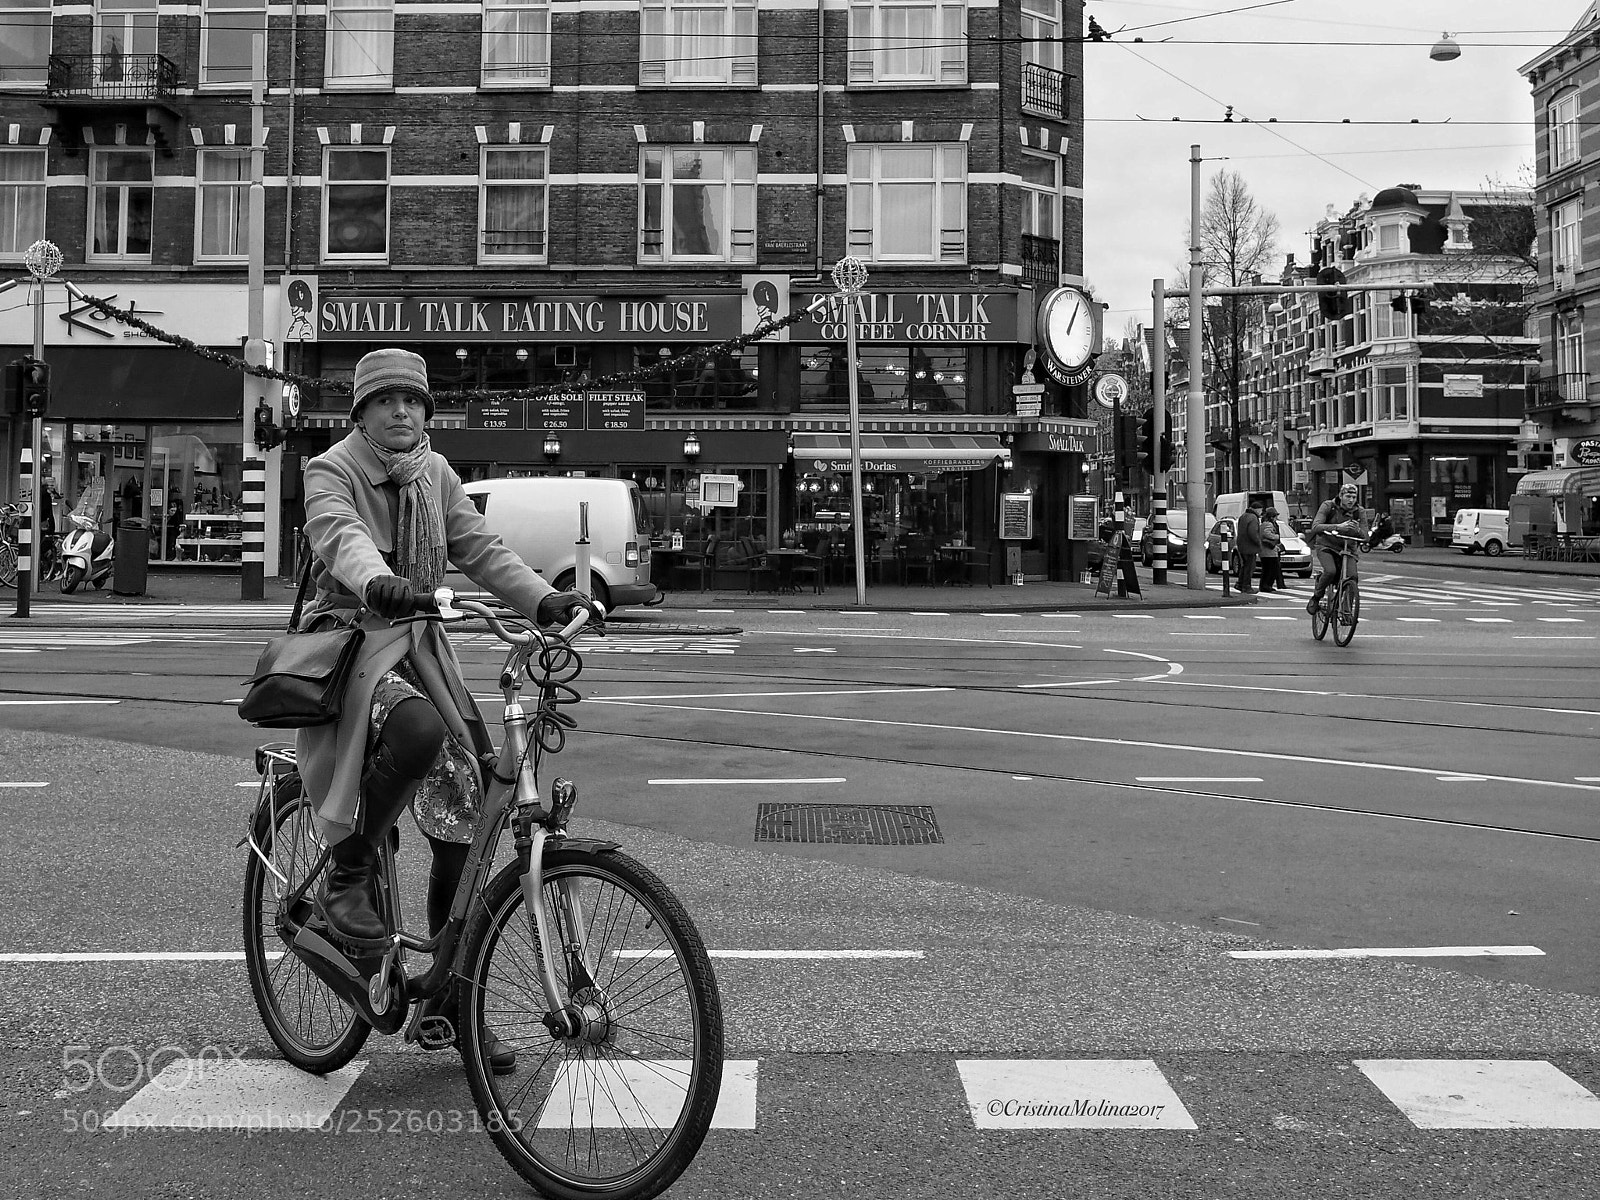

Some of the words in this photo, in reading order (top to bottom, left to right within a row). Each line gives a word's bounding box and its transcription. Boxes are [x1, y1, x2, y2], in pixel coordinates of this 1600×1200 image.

[321, 301, 411, 332] SMALL
[419, 302, 491, 332] TALK
[501, 301, 606, 333] EATING
[618, 301, 709, 333] HOUSE
[811, 293, 904, 324] SMALL
[916, 293, 991, 324] TALK
[820, 323, 895, 340] COFEE
[905, 323, 987, 341] CORNER
[1047, 358, 1093, 385] WARSTEINER
[561, 393, 583, 401] SOLE
[588, 394, 613, 402] FILET
[614, 394, 644, 402] STEAK
[865, 460, 897, 471] Dorlas
